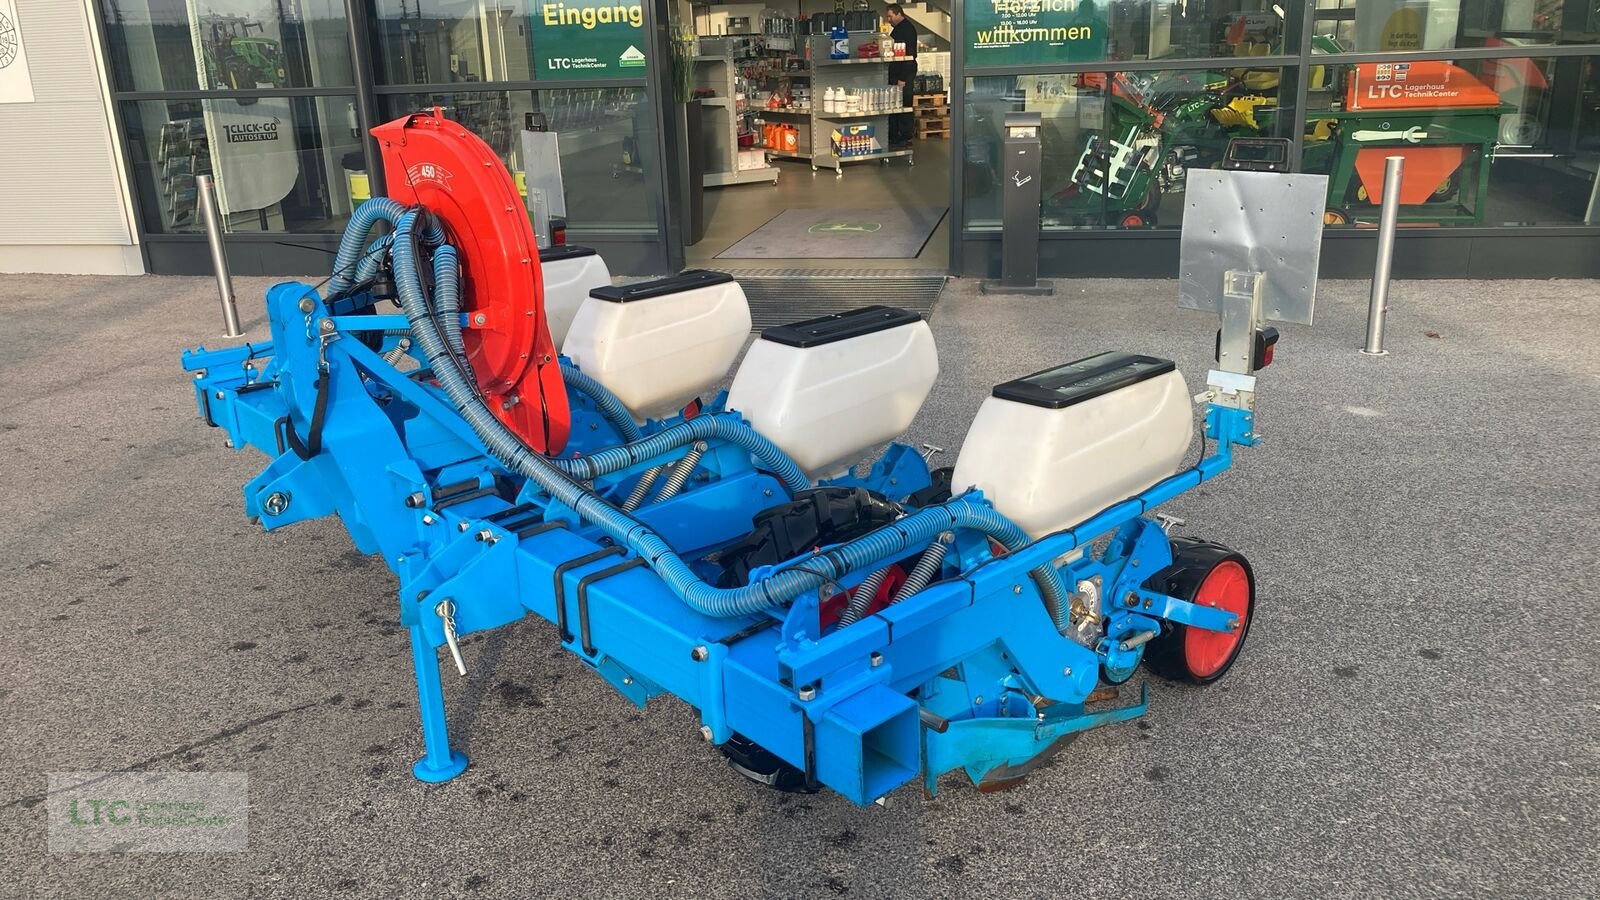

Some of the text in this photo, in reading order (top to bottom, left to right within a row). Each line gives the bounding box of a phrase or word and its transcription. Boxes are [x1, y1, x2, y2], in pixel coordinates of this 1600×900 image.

[543, 3, 644, 30] Eingang
[977, 25, 1091, 43] willkommen
[548, 58, 571, 70] LTC
[1368, 84, 1402, 99] LTC
[1405, 83, 1445, 91] Lagerhaus
[1404, 90, 1459, 98] TechnikCenter
[1187, 102, 1200, 112] LTC
[231, 122, 277, 133] CLICK-GO
[233, 133, 277, 141] AUTOSETUP
[422, 166, 435, 178] 450
